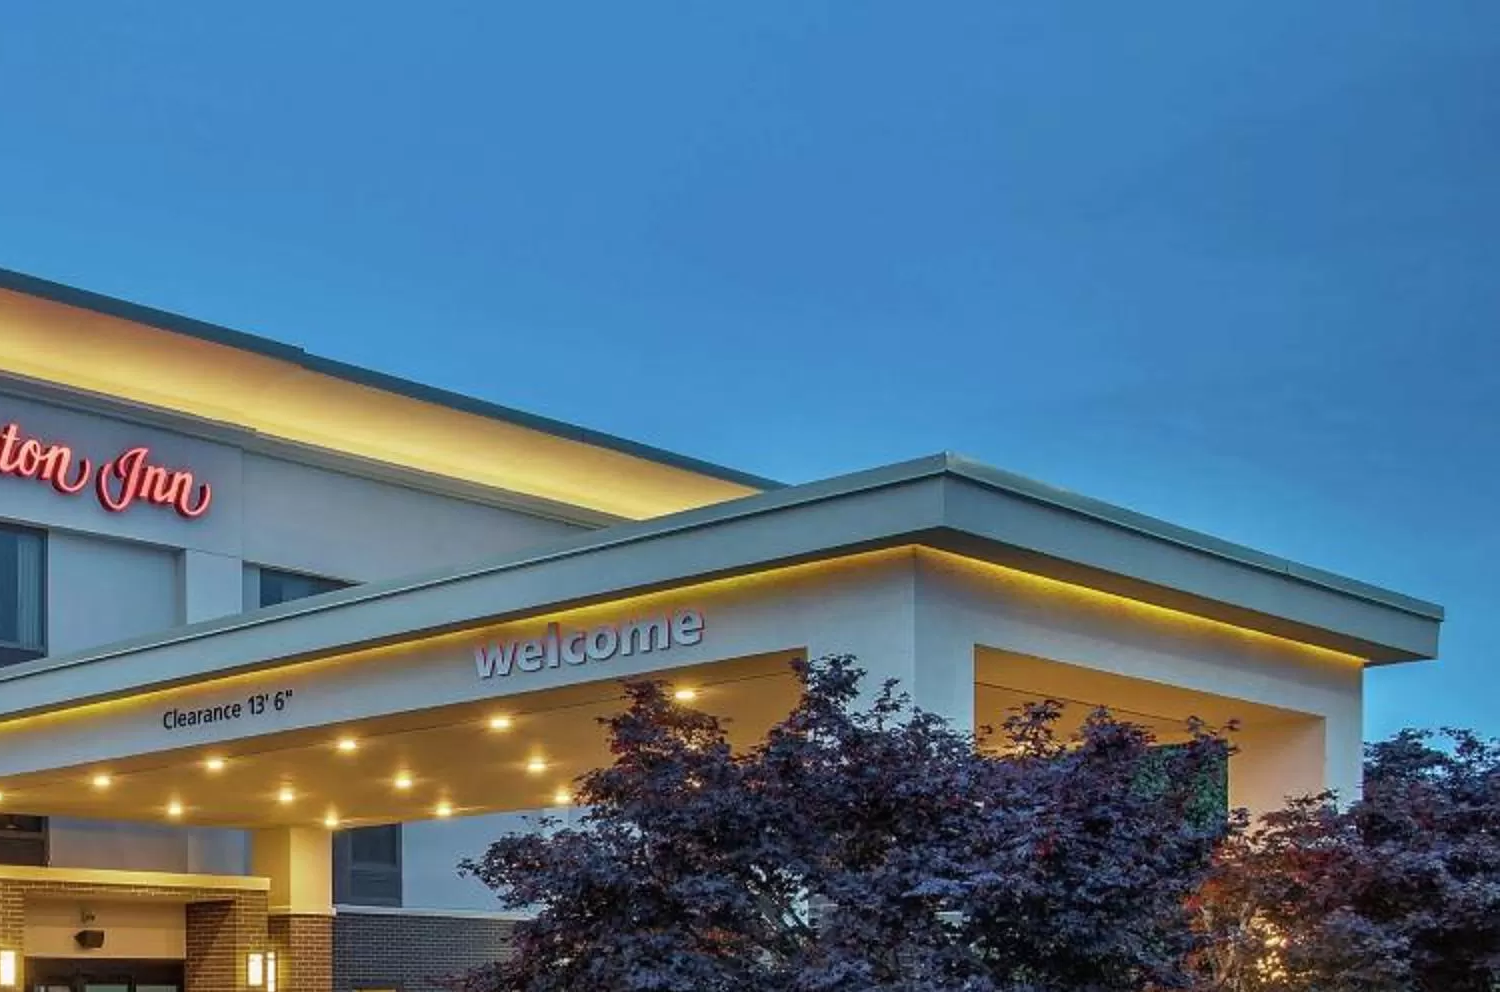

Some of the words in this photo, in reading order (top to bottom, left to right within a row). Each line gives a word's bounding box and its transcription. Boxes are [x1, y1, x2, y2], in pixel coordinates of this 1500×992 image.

[96, 447, 211, 517] Inn
[475, 608, 705, 678] welcome
[163, 703, 242, 730] Clearance
[247, 693, 269, 715] 13'
